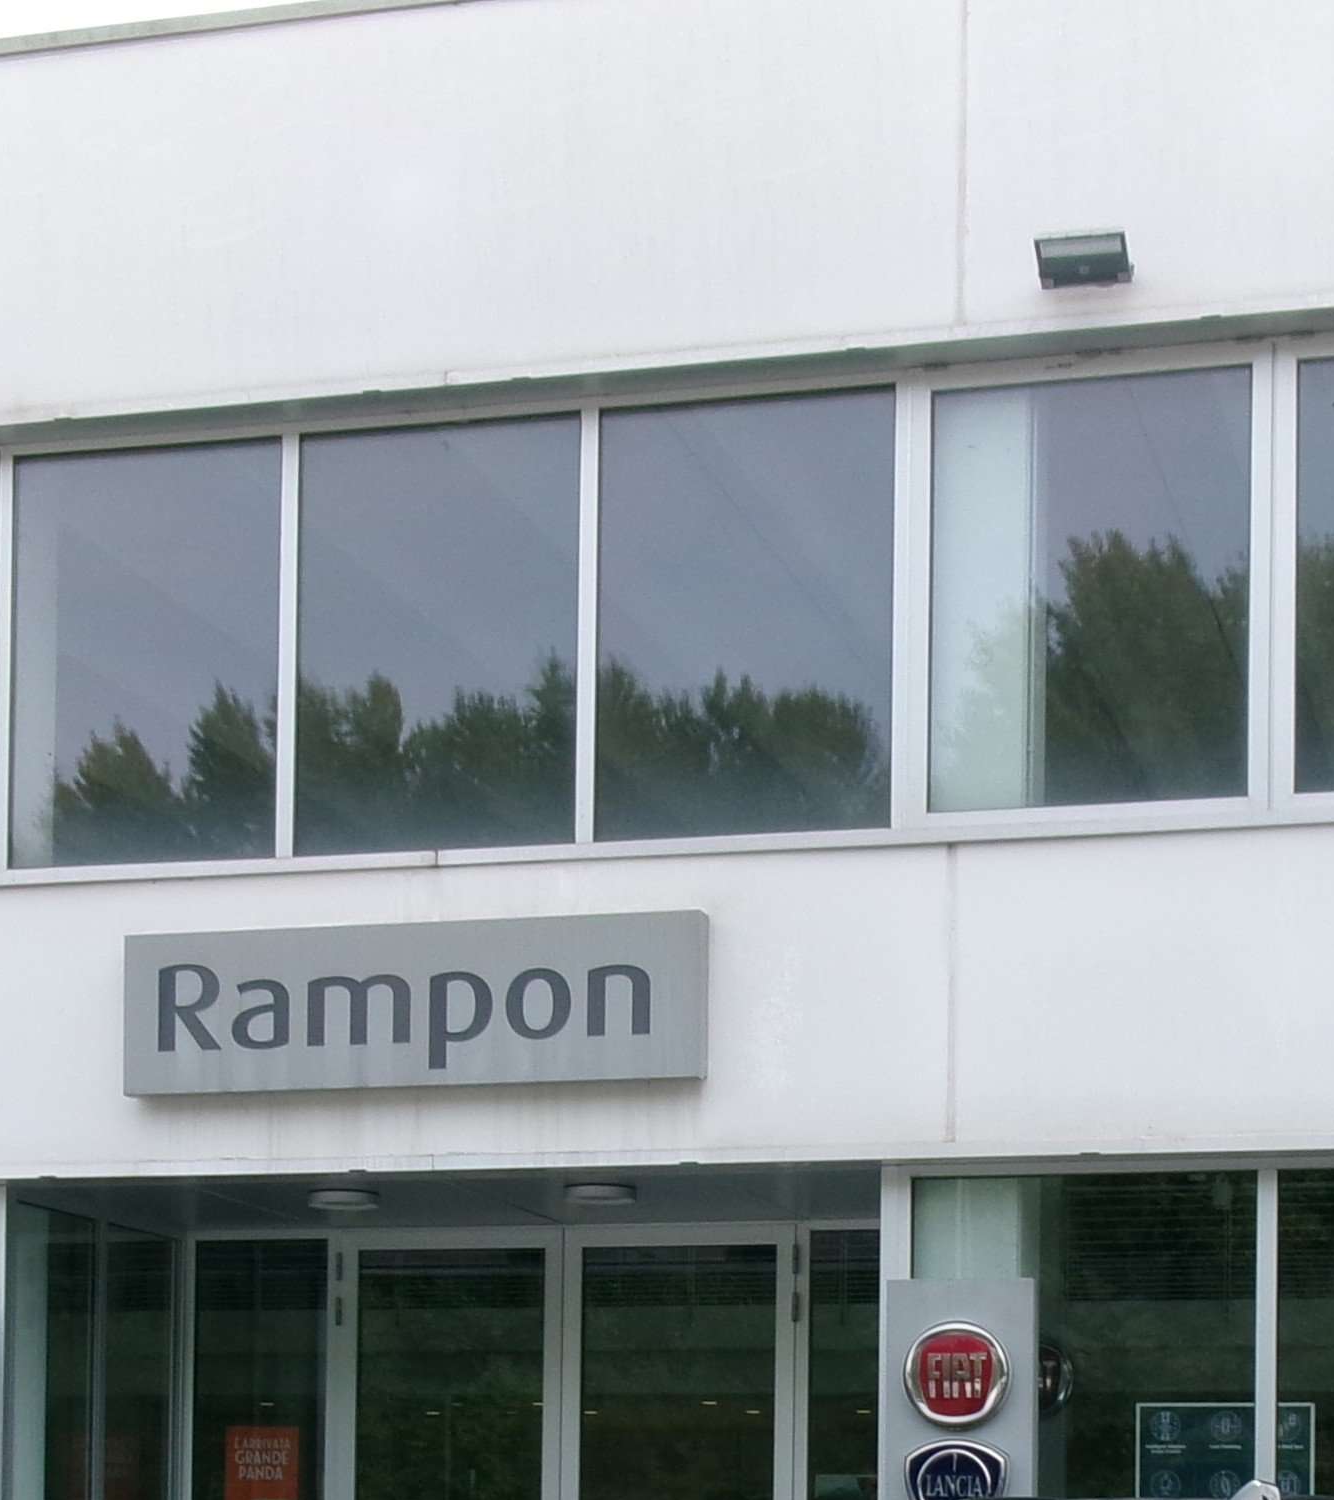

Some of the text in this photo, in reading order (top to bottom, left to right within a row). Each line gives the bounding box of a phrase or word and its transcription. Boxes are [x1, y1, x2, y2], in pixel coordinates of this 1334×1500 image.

[157, 962, 651, 1070] Rampon
[926, 1352, 988, 1399] FIAT
[234, 1450, 290, 1465] GRANDE
[238, 1465, 284, 1481] PANDA
[925, 1474, 984, 1498] LANCIA
